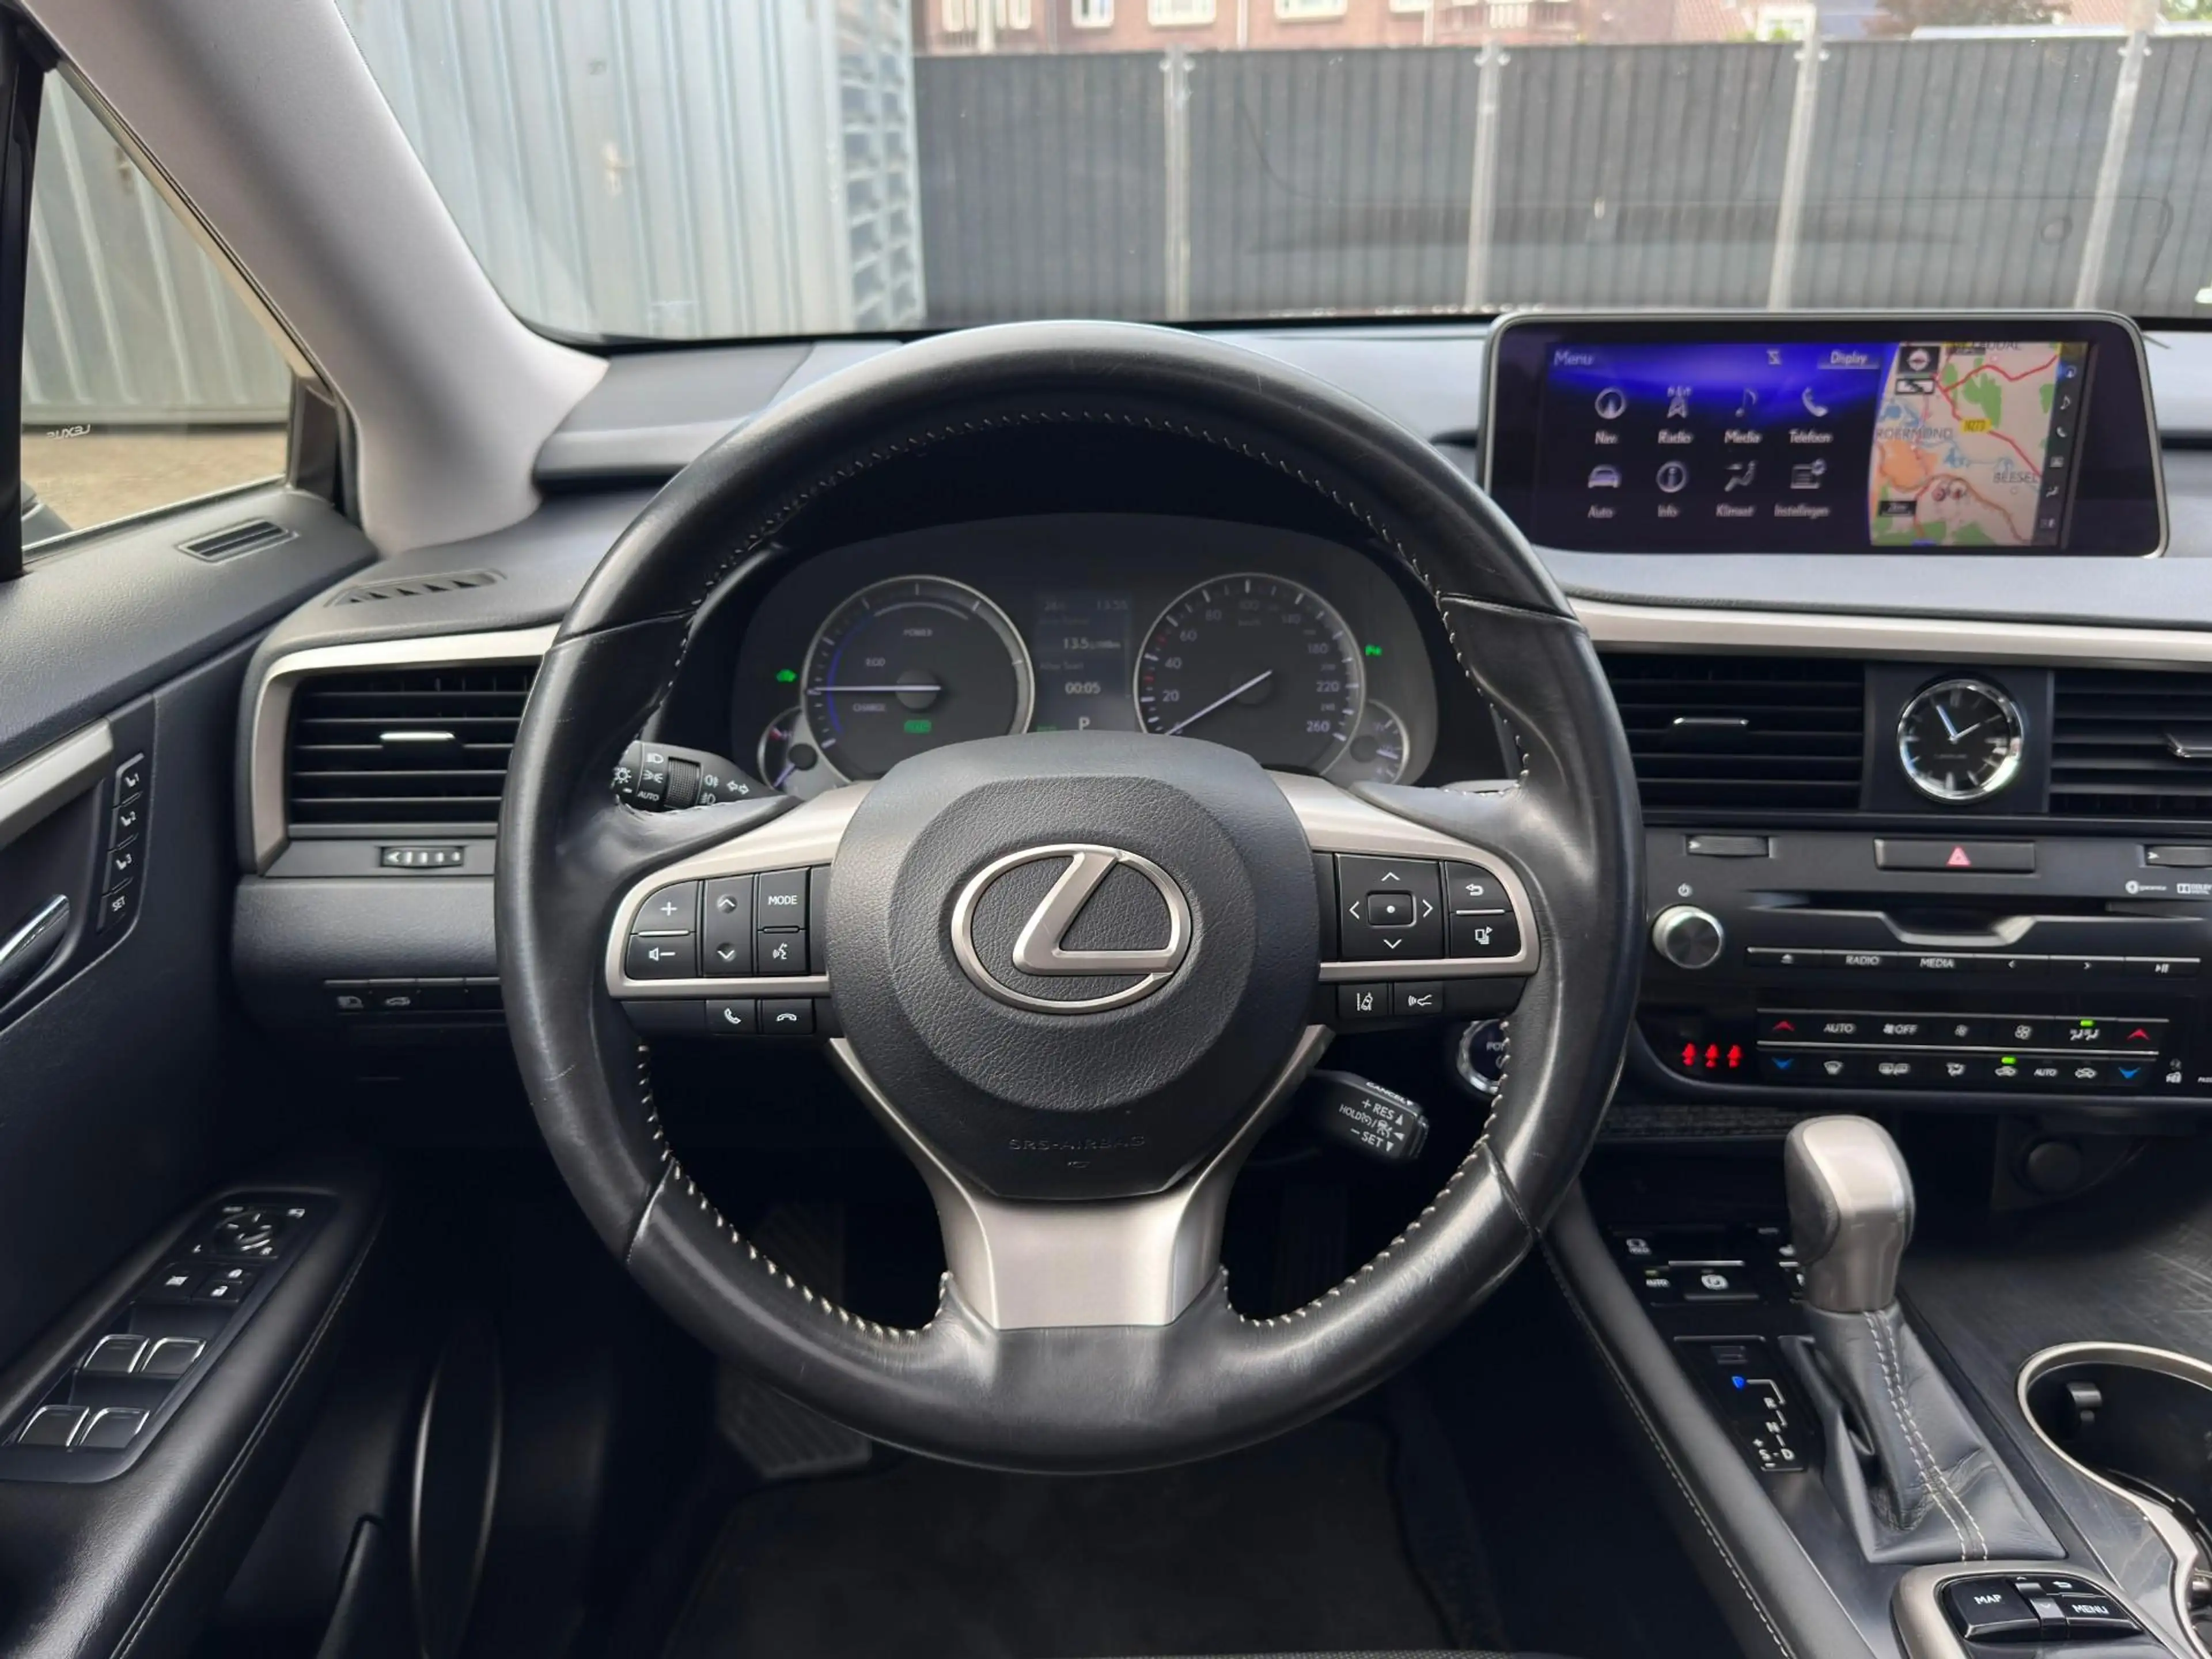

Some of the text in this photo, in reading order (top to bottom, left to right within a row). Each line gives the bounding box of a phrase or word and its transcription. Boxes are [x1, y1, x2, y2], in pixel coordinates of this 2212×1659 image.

[1554, 350, 1594, 366] Menu
[1831, 351, 1868, 366] Display
[1658, 430, 1693, 444] Radio
[1725, 430, 1762, 444] Media
[1789, 429, 1832, 444] Telefoon
[1588, 505, 1615, 518] Auto
[1658, 505, 1680, 518] Info
[1716, 504, 1755, 517] Klimaat
[1206, 609, 1222, 621] 80
[1180, 630, 1198, 642] 60
[1308, 643, 1328, 654] 180
[1165, 657, 1183, 670] 40
[1065, 682, 1101, 695] 00:05
[1316, 680, 1340, 692] 220
[1162, 690, 1180, 702] 20
[1078, 717, 1090, 730] P
[1306, 720, 1330, 733] 260
[638, 791, 660, 801] AUTO
[767, 895, 798, 906] MODE
[1845, 955, 1880, 966] RADIO
[1919, 957, 1956, 969] MEDIA
[1823, 1023, 1856, 1033] AUTO
[1894, 1024, 1918, 1035] OFF
[2033, 1068, 2058, 1078] AUTO
[1338, 1103, 1362, 1121] HOLD
[1781, 1448, 1796, 1461] D
[1974, 1593, 2002, 1605] MAP
[2071, 1604, 2107, 1615] MENU
